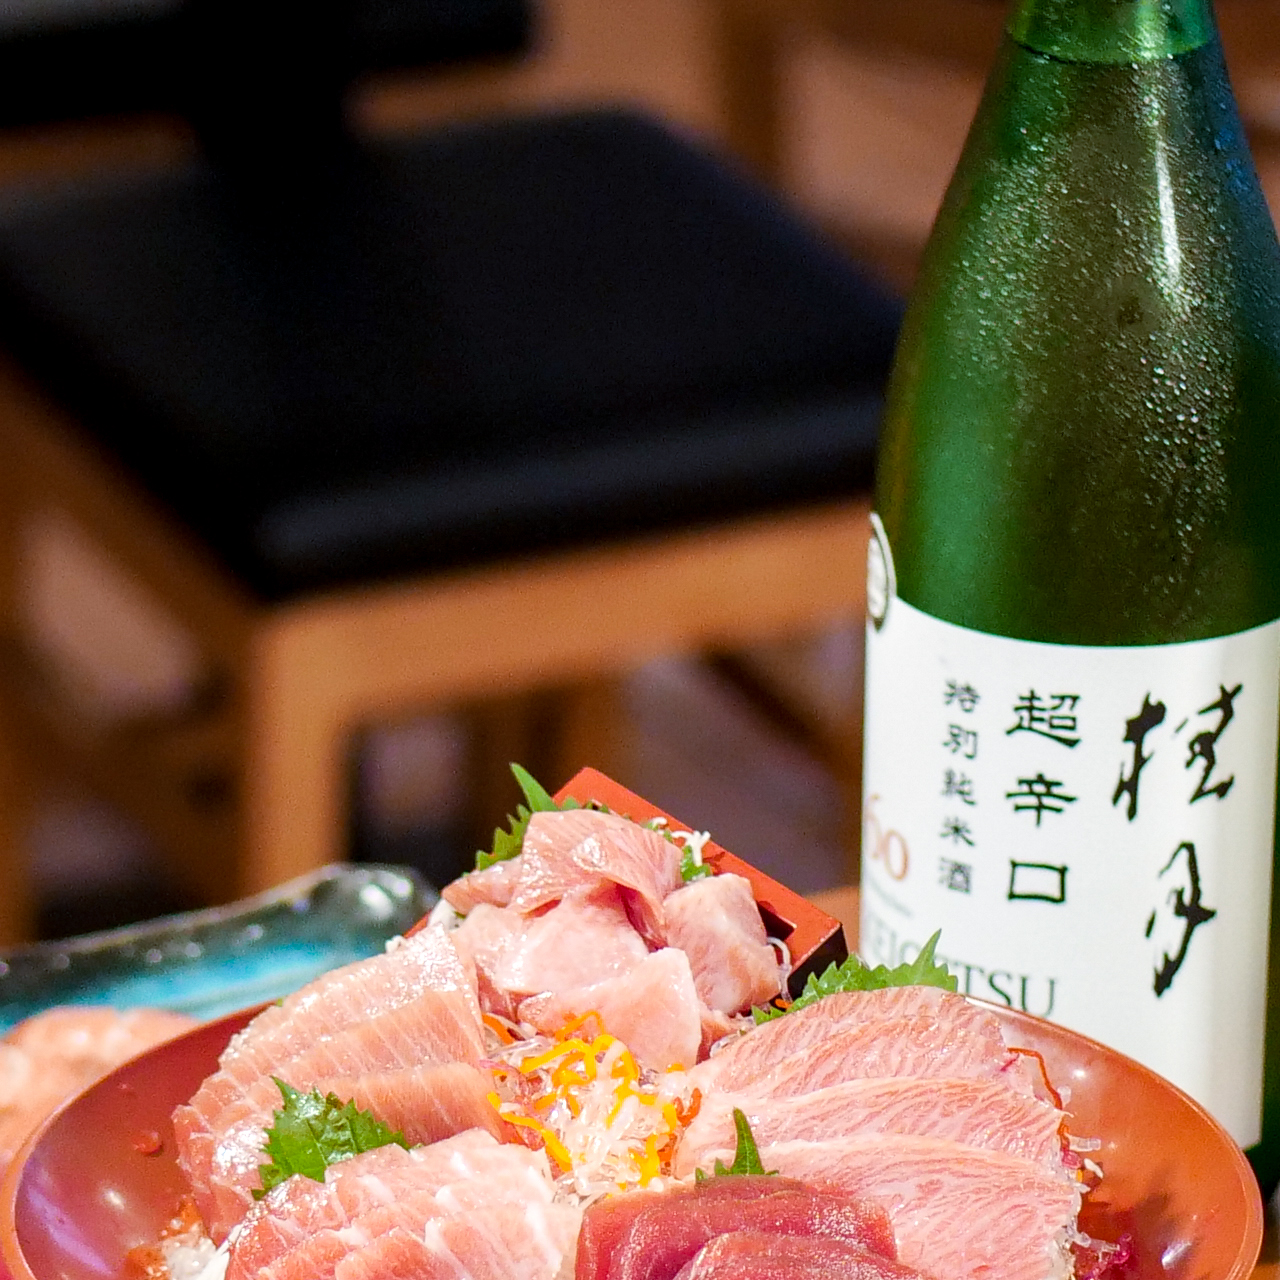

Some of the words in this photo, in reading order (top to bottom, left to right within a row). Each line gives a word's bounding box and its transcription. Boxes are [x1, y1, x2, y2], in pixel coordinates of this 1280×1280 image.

[937, 677, 981, 895] 特別純米酒
[1004, 687, 1082, 905] 超辛口
[1111, 682, 1244, 999] 桂月
